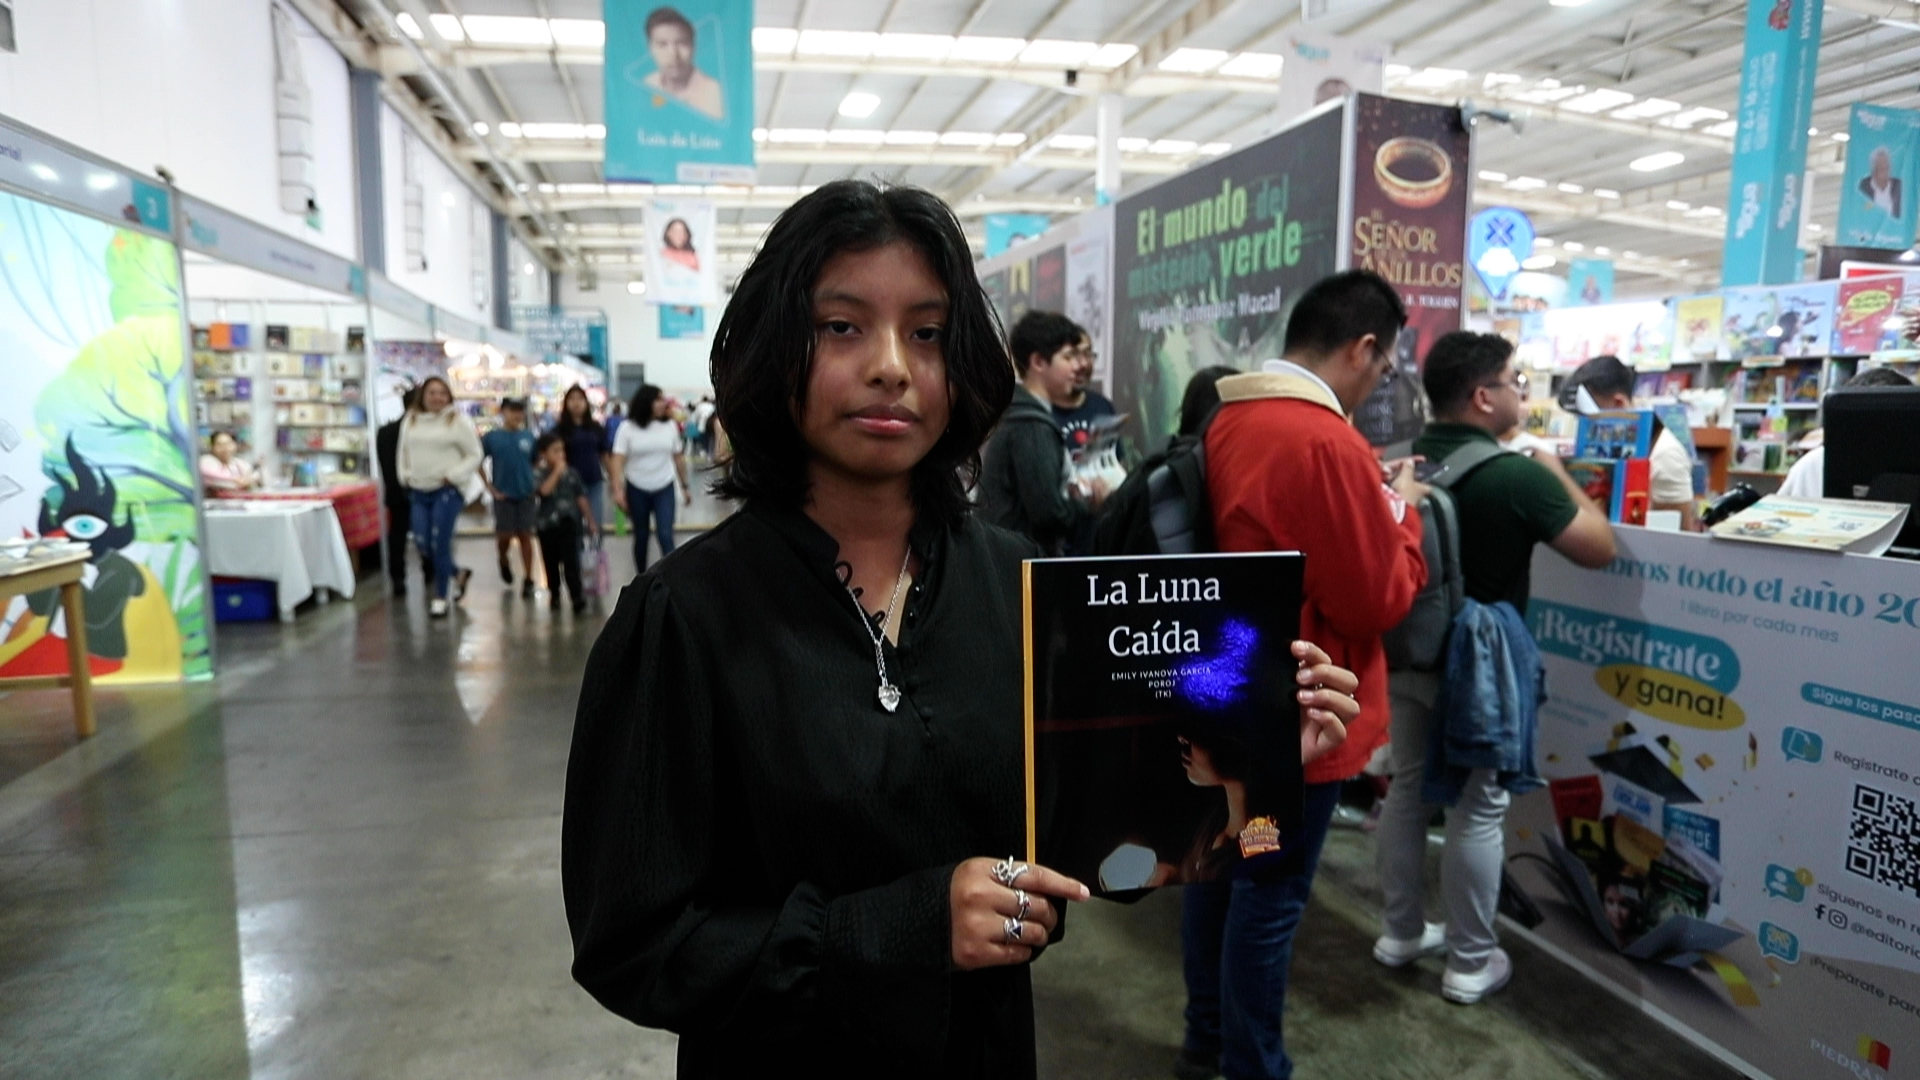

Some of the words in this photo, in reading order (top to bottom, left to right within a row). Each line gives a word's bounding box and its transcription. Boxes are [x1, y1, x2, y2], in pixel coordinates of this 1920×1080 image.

[670, 130, 687, 147] de
[1136, 207, 1156, 256] El
[1163, 177, 1247, 249] mundo
[1256, 173, 1290, 220] del
[1219, 211, 1303, 279] verde
[1353, 216, 1439, 256] SEÑOR
[1360, 254, 1463, 288] ANILLOS
[1087, 574, 1129, 606] La
[1137, 572, 1221, 604] Luna
[1677, 564, 1747, 597] todo
[1753, 577, 1783, 603] el
[1789, 580, 1865, 618] año
[1108, 619, 1201, 657] Caída
[1687, 601, 1721, 619] libro
[1723, 610, 1749, 624] por
[1753, 615, 1796, 634] cada
[1801, 625, 1840, 643] mes
[1535, 609, 1722, 681] ¡Regístrate
[1111, 671, 1137, 681] EMILY
[1139, 668, 1178, 680] IVANOVA
[1148, 679, 1176, 689] POROJ
[1155, 690, 1172, 699] (TK)
[1615, 670, 1631, 698] y
[1637, 678, 1725, 720] gana!
[1812, 687, 1853, 706] Sigue
[1857, 698, 1879, 713] los
[1886, 914, 1906, 930] en
